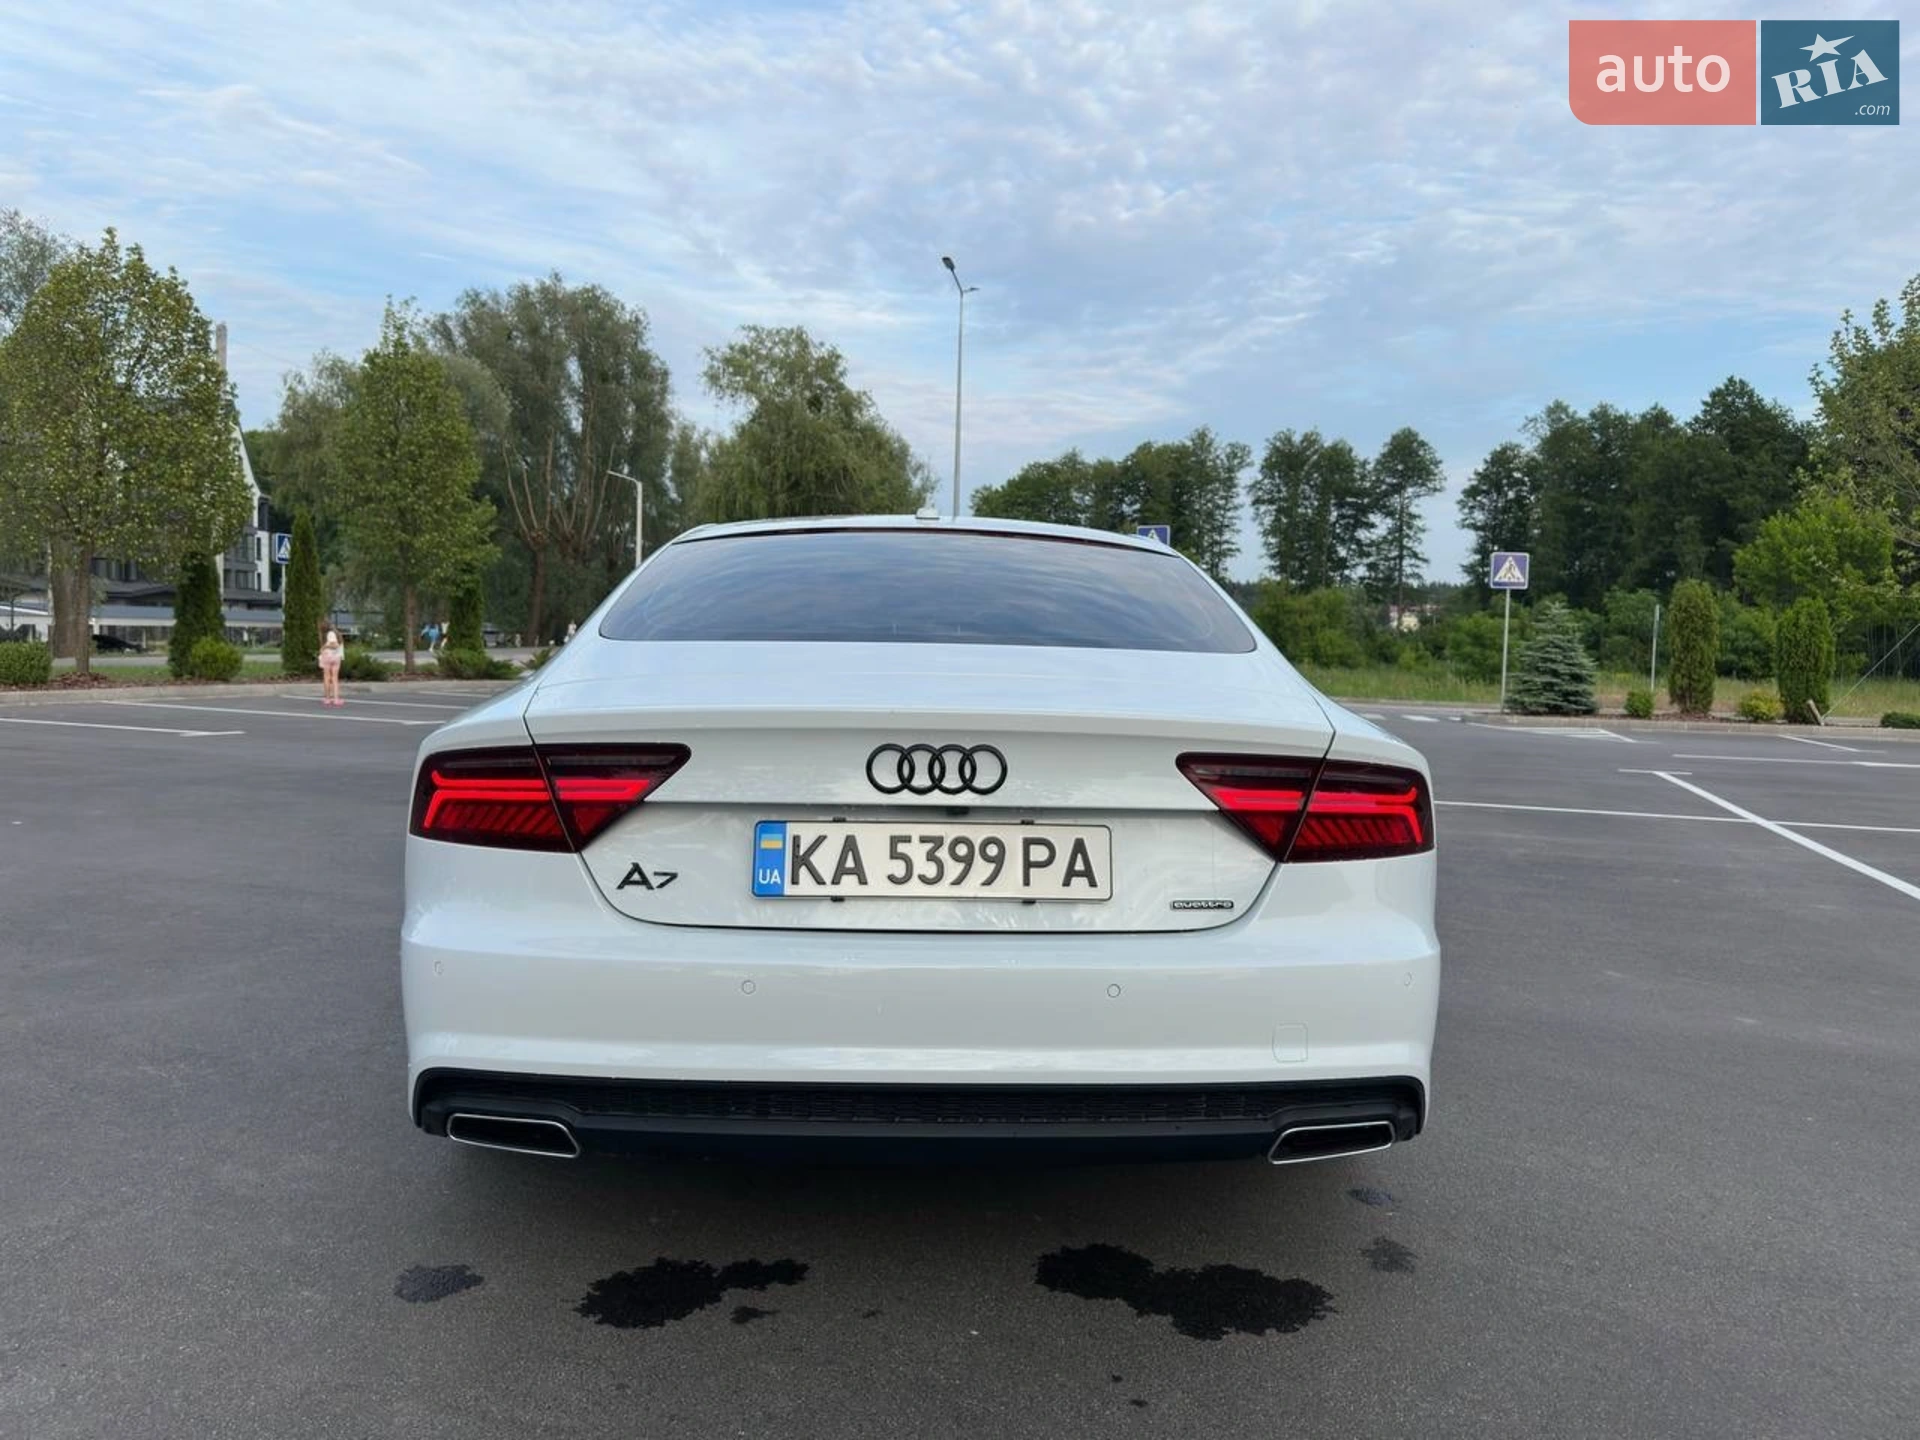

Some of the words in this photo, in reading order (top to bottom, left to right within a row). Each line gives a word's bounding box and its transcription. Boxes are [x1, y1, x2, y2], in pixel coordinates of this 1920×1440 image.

[615, 861, 679, 891] A7
[790, 834, 868, 886] KA
[887, 835, 1006, 887] 5399
[1021, 837, 1098, 888] PA
[758, 868, 781, 885] UA
